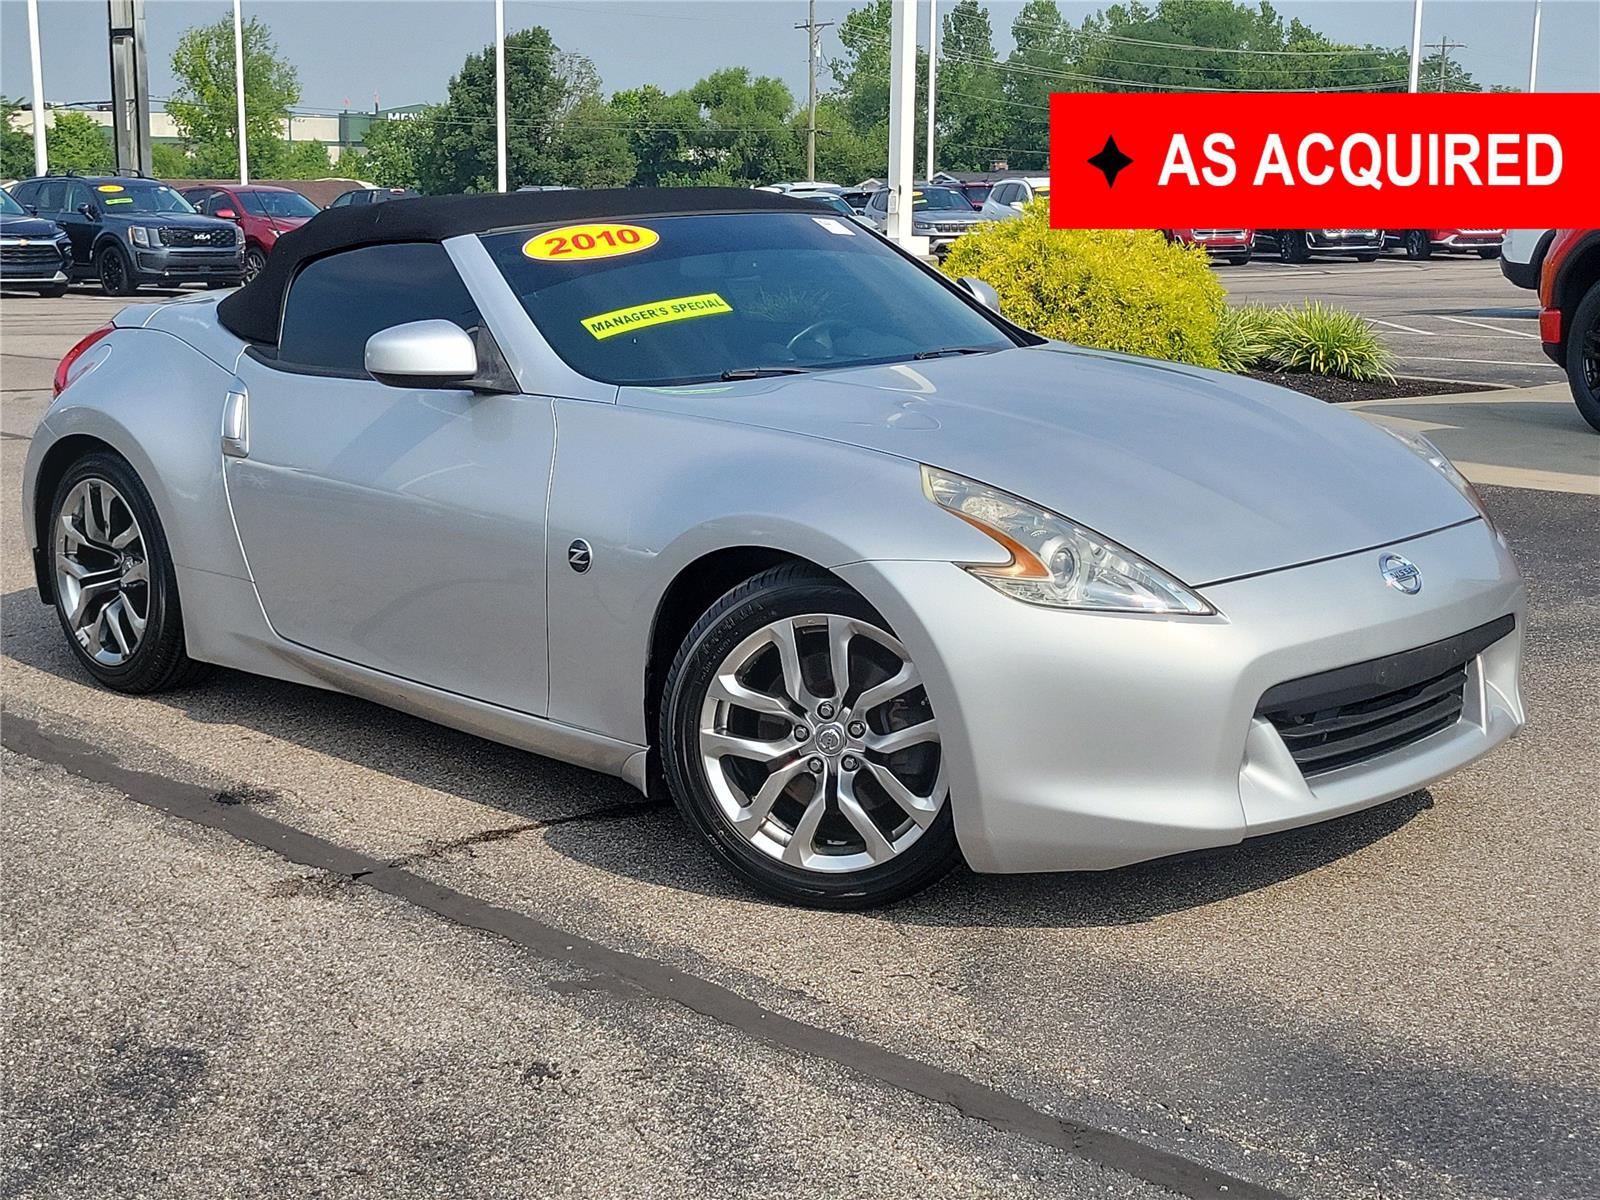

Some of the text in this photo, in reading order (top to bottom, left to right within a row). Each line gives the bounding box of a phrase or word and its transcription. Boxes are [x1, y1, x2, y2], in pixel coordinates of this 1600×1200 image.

[544, 228, 640, 256] 2010
[591, 298, 725, 333] MANAGER'S SPECIAL
[569, 548, 588, 564] Z
